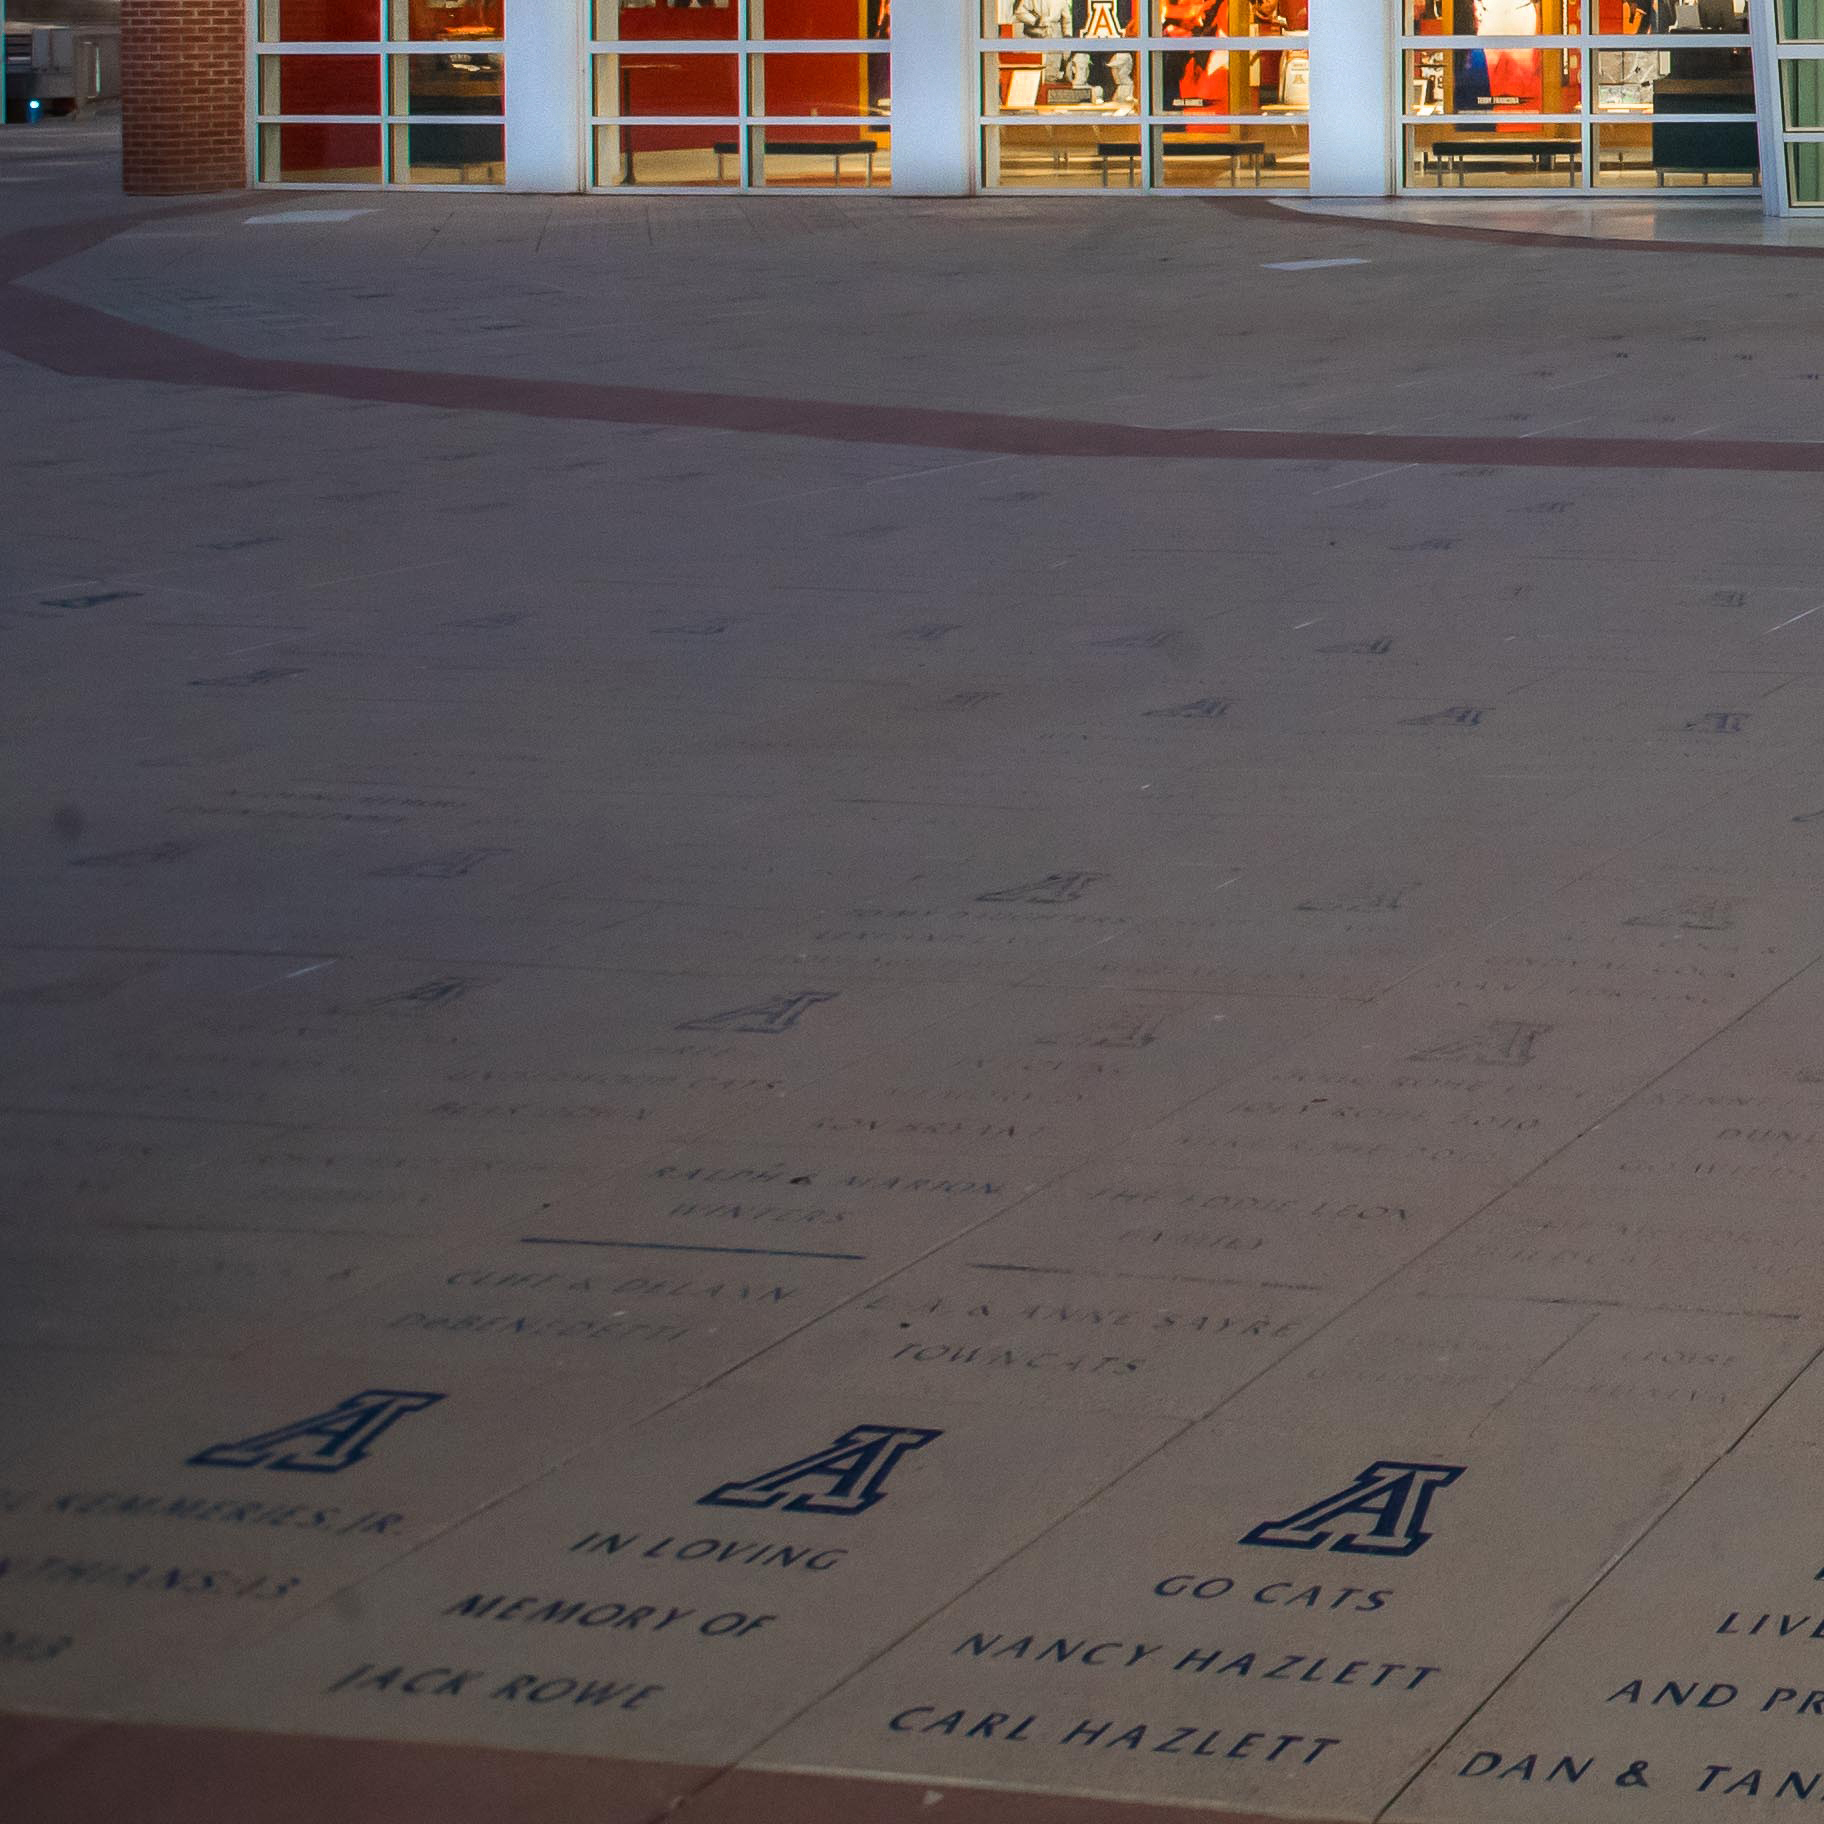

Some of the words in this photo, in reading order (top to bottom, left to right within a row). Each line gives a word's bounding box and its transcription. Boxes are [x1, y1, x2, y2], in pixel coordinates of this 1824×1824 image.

[186, 1390, 450, 1473] A
[692, 1422, 946, 1517] A
[1238, 1460, 1468, 1557] A
[567, 1530, 636, 1556] IN
[640, 1535, 849, 1574] LOVING
[440, 1592, 697, 1632] MEMORY
[697, 1611, 780, 1639] OF
[1151, 1573, 1236, 1601] GO
[1251, 1579, 1396, 1613] CATS
[950, 1631, 1165, 1668] NANCY
[1171, 1647, 1446, 1692] HAZLETT
[325, 1662, 485, 1697] JACK
[488, 1673, 666, 1712] ROWE
[1604, 1677, 1740, 1710] AND
[887, 1704, 1039, 1743] CARL
[1058, 1717, 1343, 1767] HAZLETT
[1456, 1749, 1597, 1785] DAN
[1613, 1758, 1651, 1791] &
